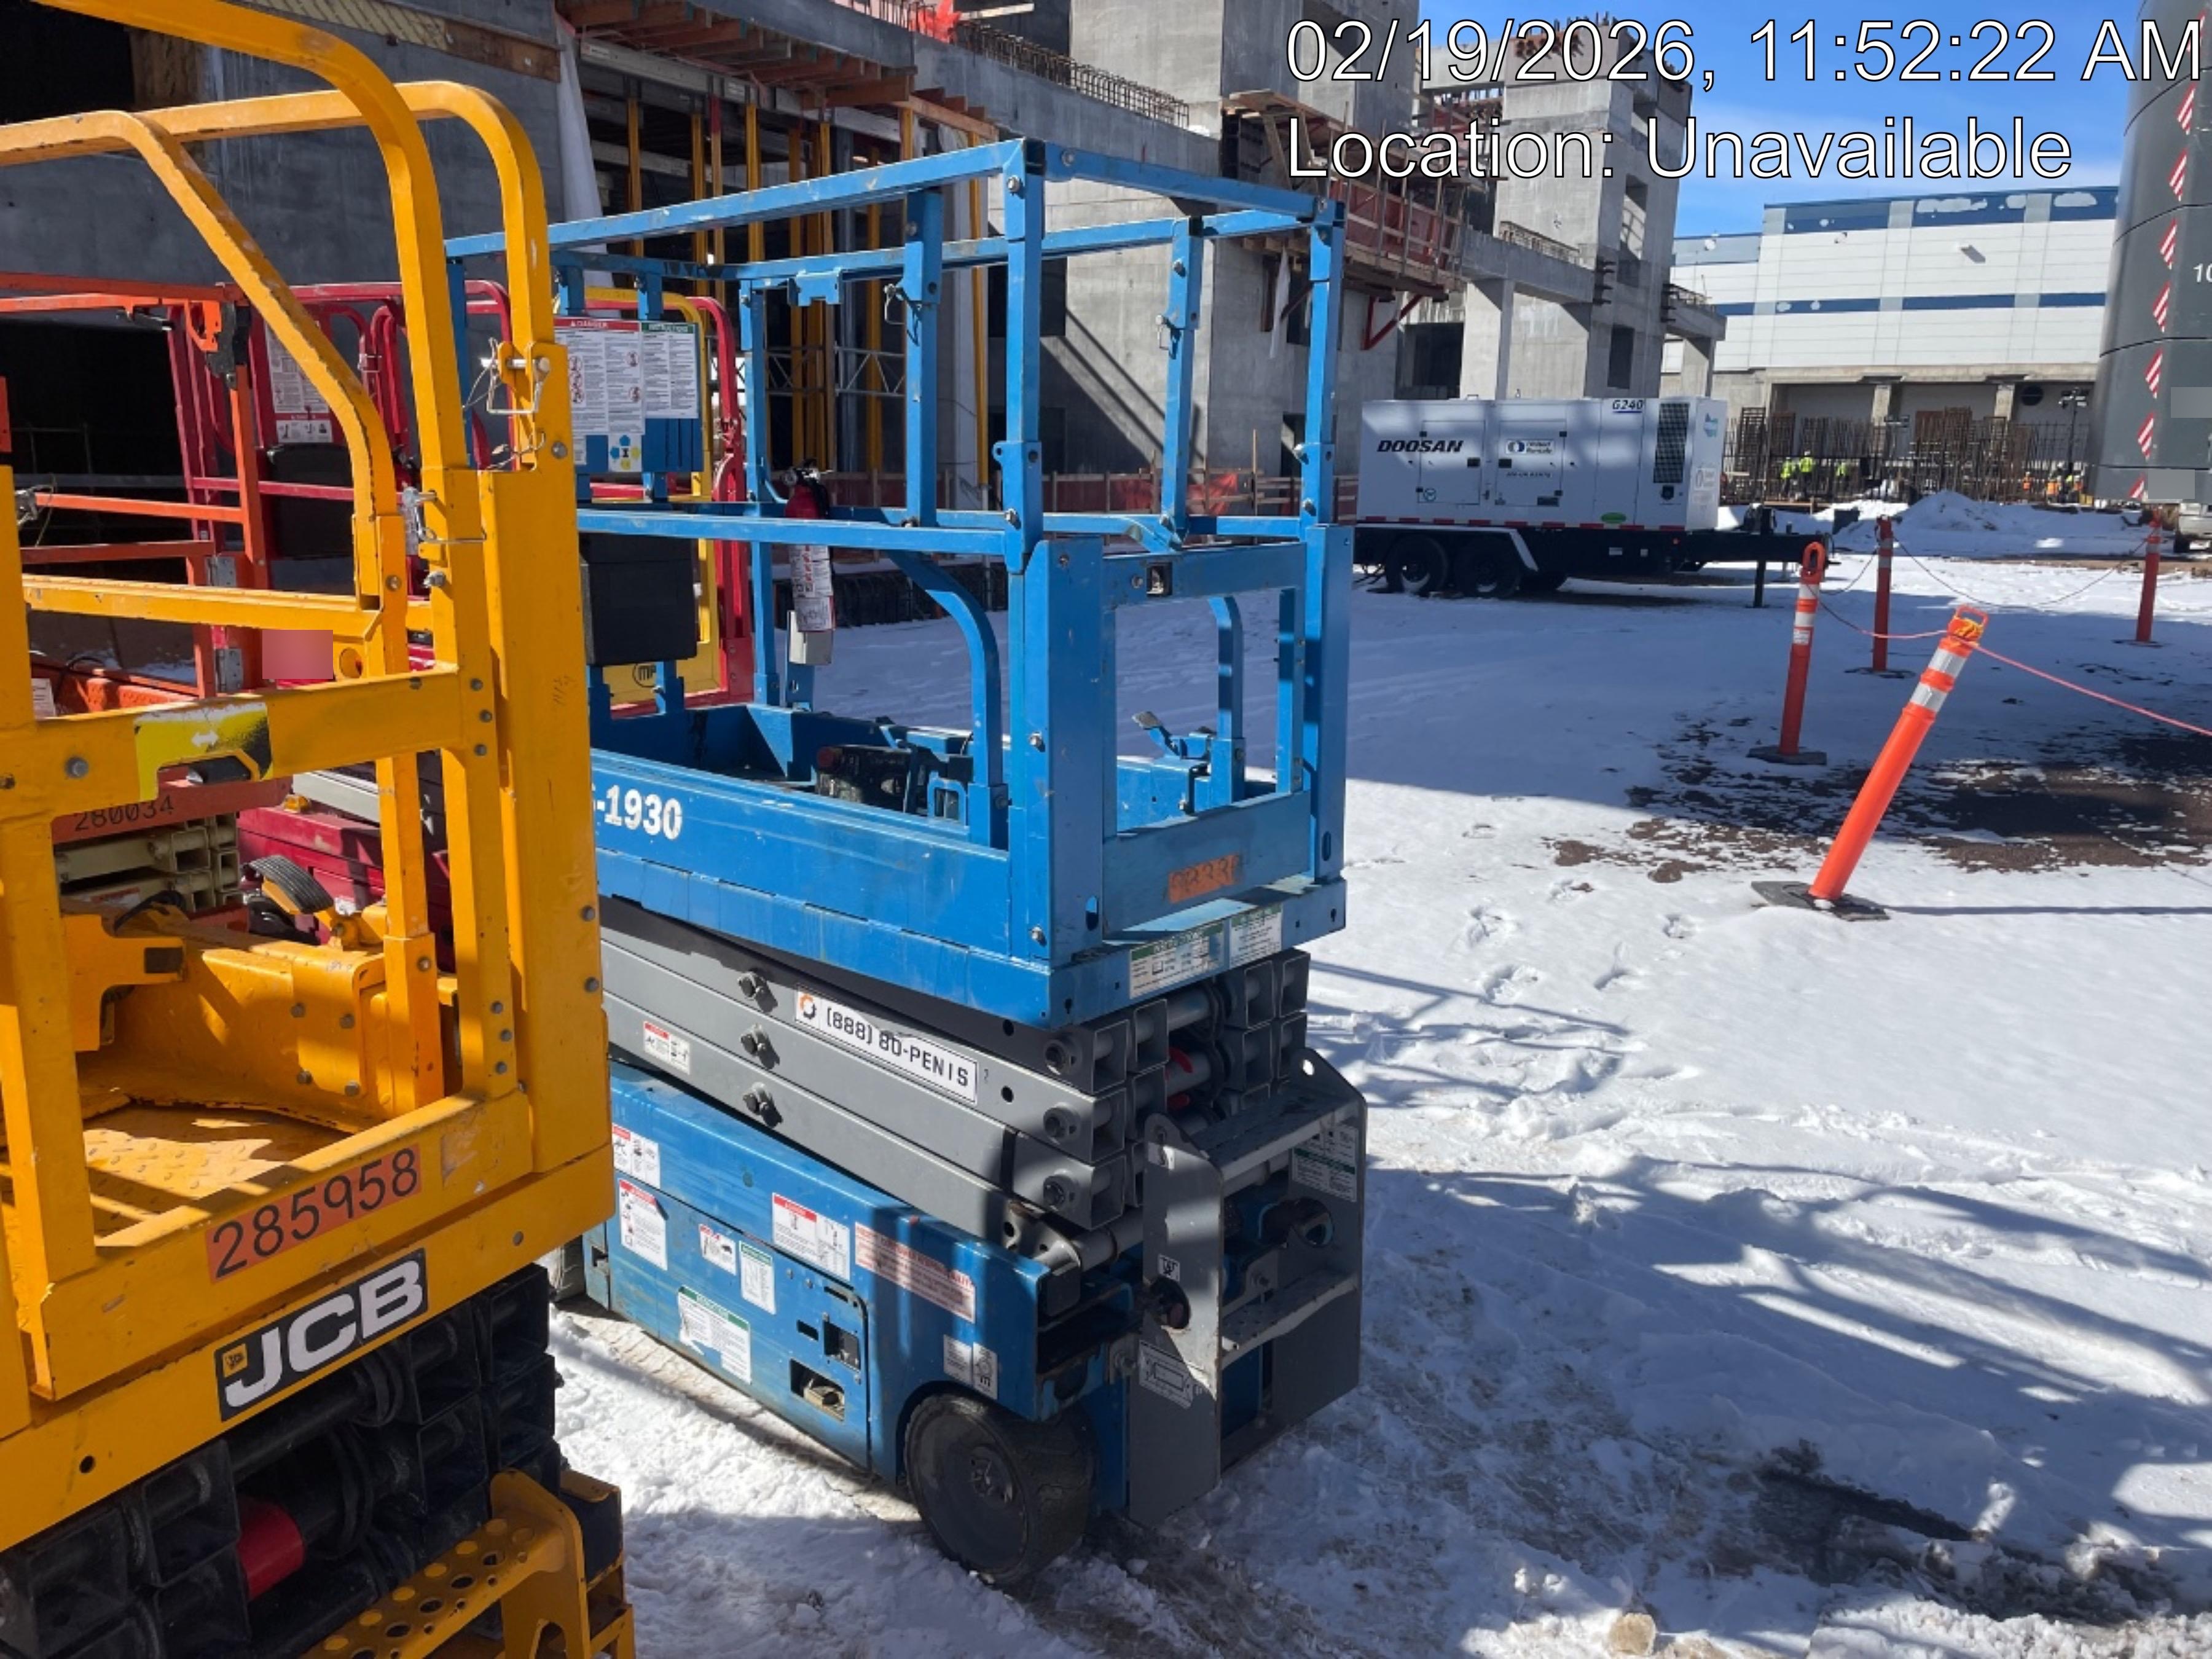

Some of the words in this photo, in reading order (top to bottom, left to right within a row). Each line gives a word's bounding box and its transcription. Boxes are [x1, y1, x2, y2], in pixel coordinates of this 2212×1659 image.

[1612, 400, 1643, 410] G240
[1376, 440, 1464, 452] DOOSAN
[592, 783, 683, 840] -1930
[827, 1007, 873, 1045] (888)
[213, 1147, 419, 1278] 285958
[225, 1260, 424, 1408] JCB
